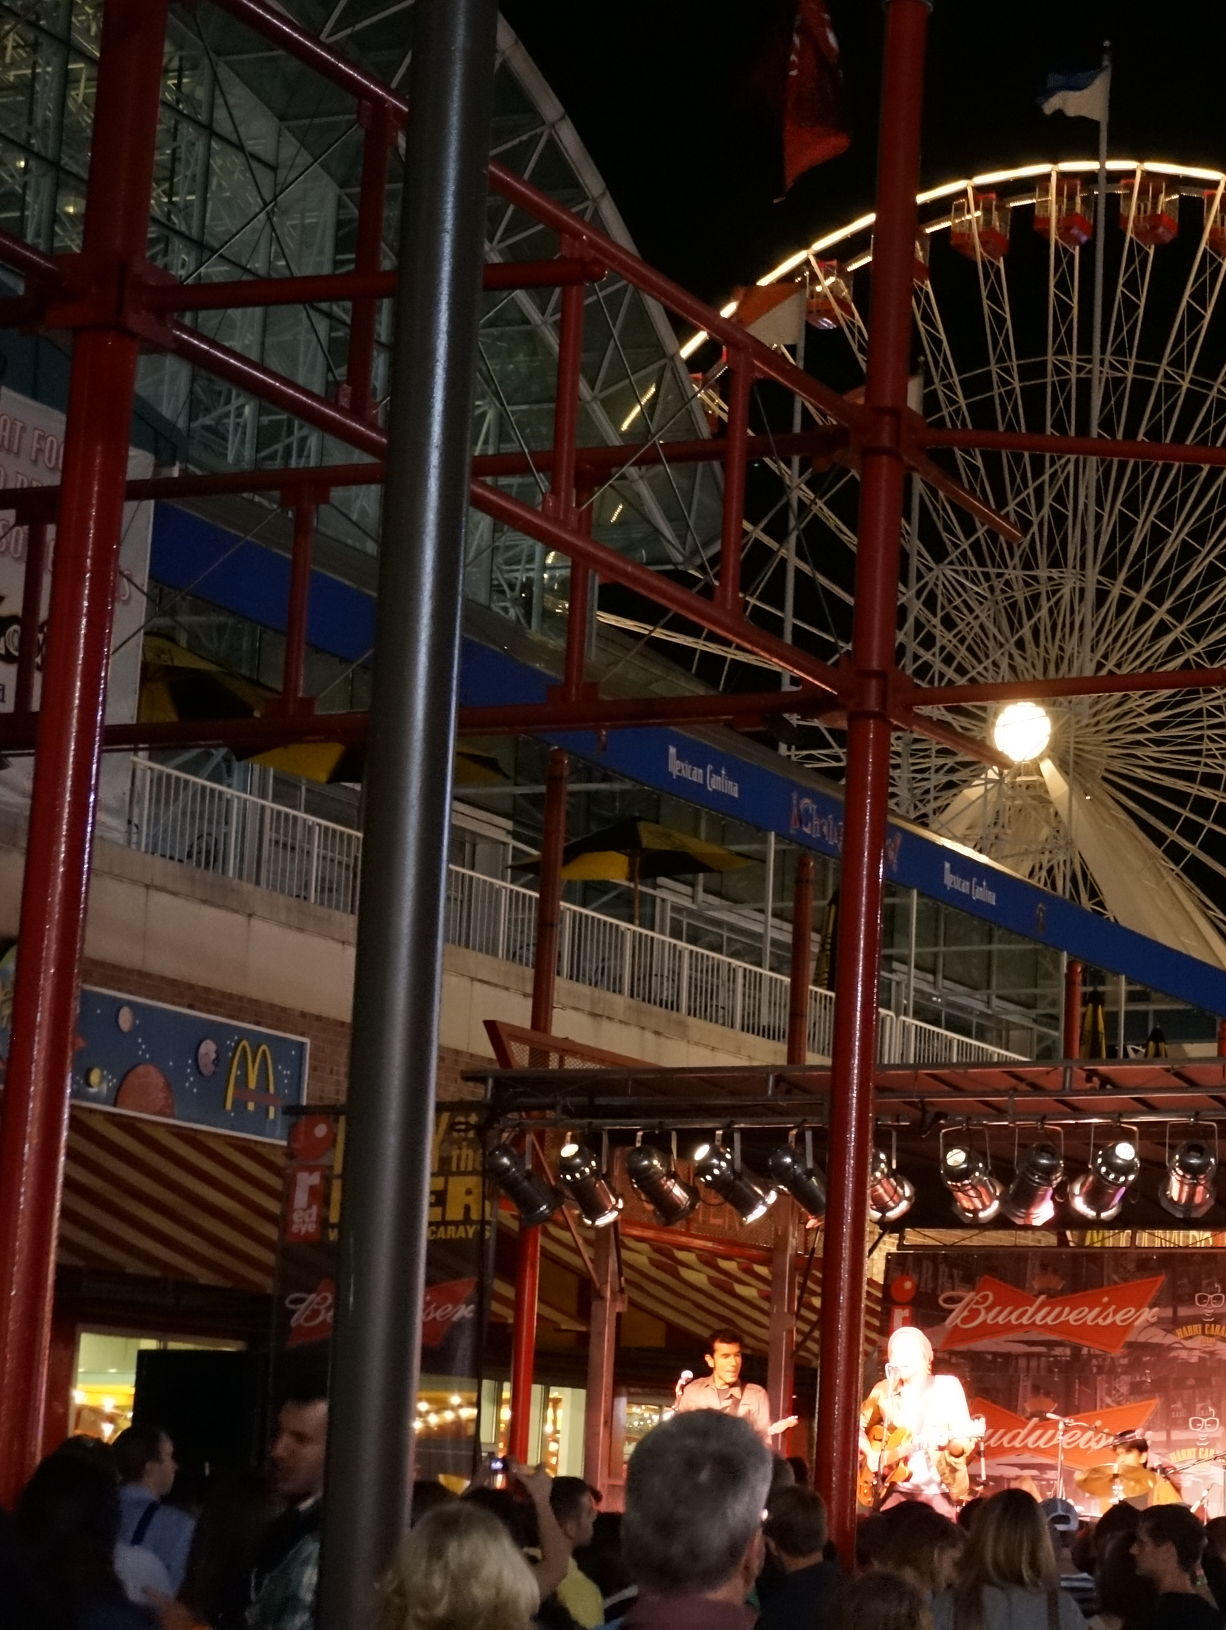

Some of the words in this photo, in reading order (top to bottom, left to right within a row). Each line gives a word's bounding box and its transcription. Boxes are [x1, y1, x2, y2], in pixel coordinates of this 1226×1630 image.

[668, 745, 704, 785] Mexican
[706, 764, 739, 798] Cantina
[938, 1290, 1160, 1330] Budweiser
